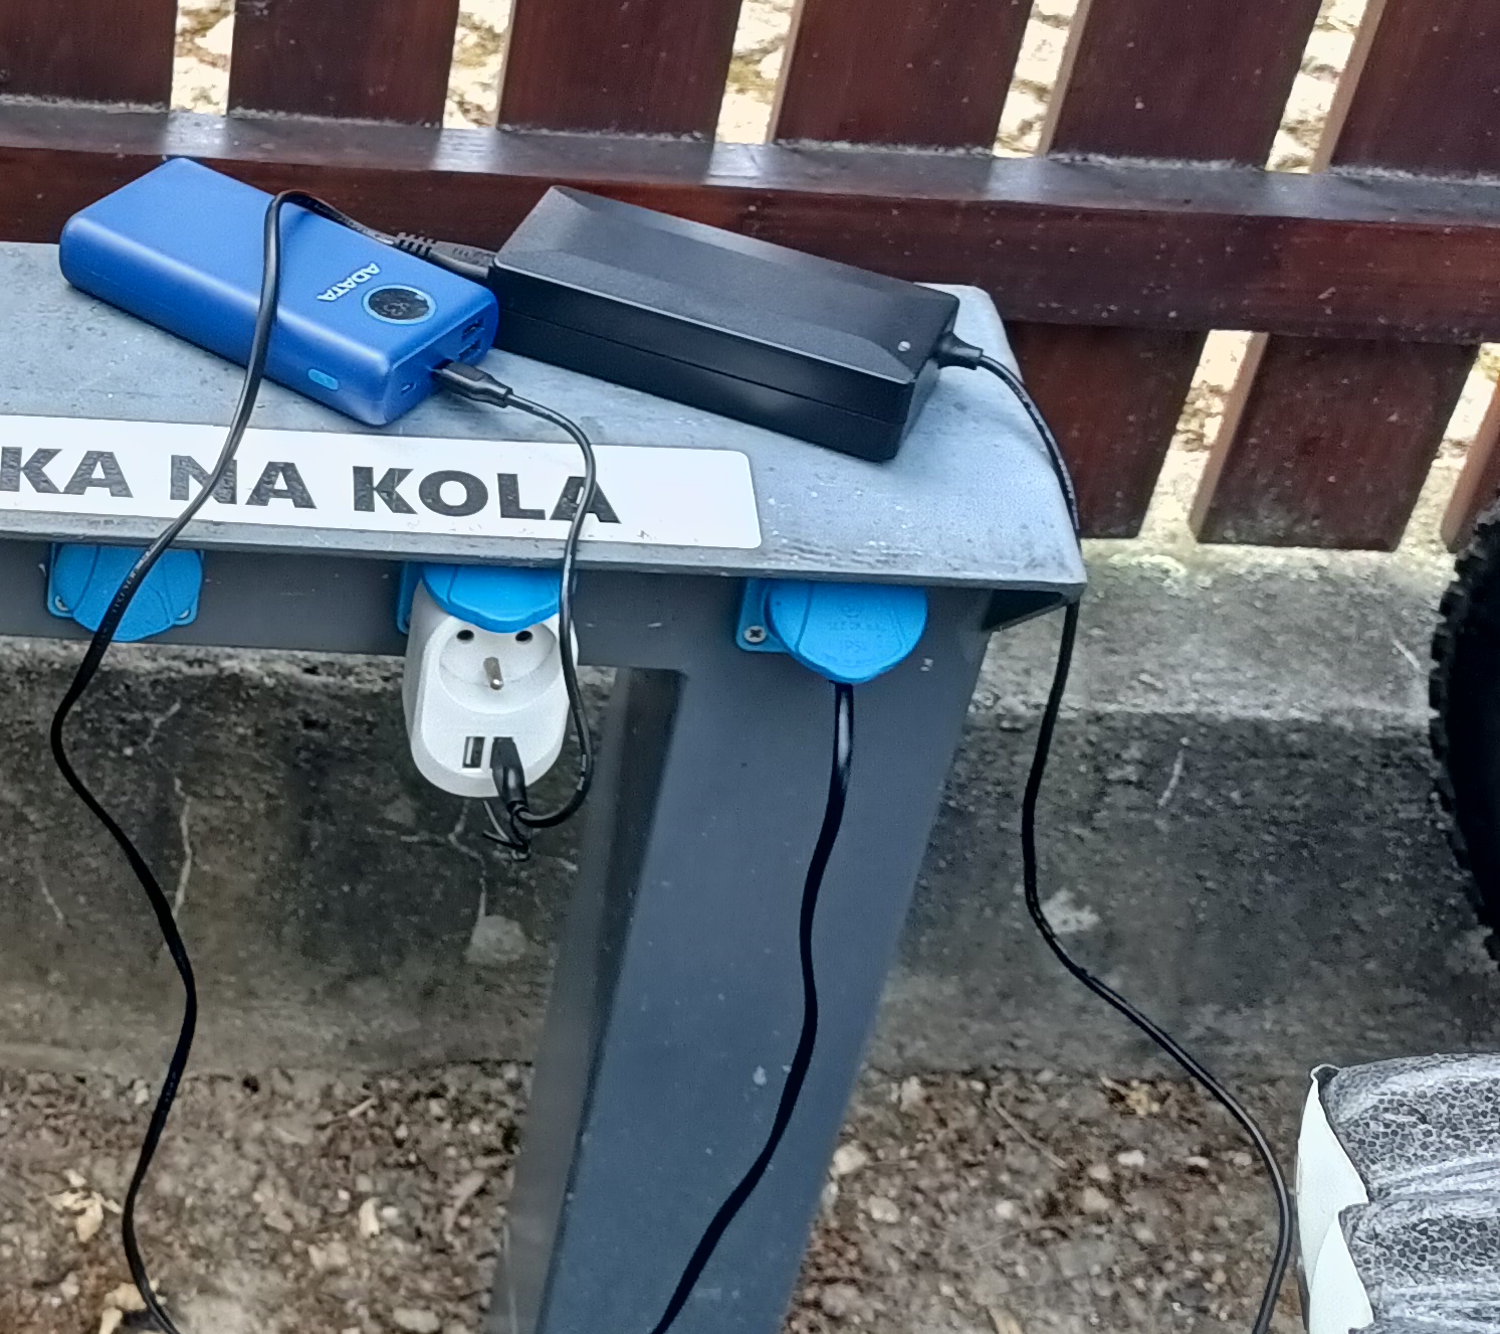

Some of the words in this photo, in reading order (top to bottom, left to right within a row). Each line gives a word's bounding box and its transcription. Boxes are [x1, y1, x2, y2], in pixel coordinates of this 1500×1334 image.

[315, 261, 381, 302] ADATA
[169, 454, 318, 509] NA
[352, 465, 621, 524] KOLA
